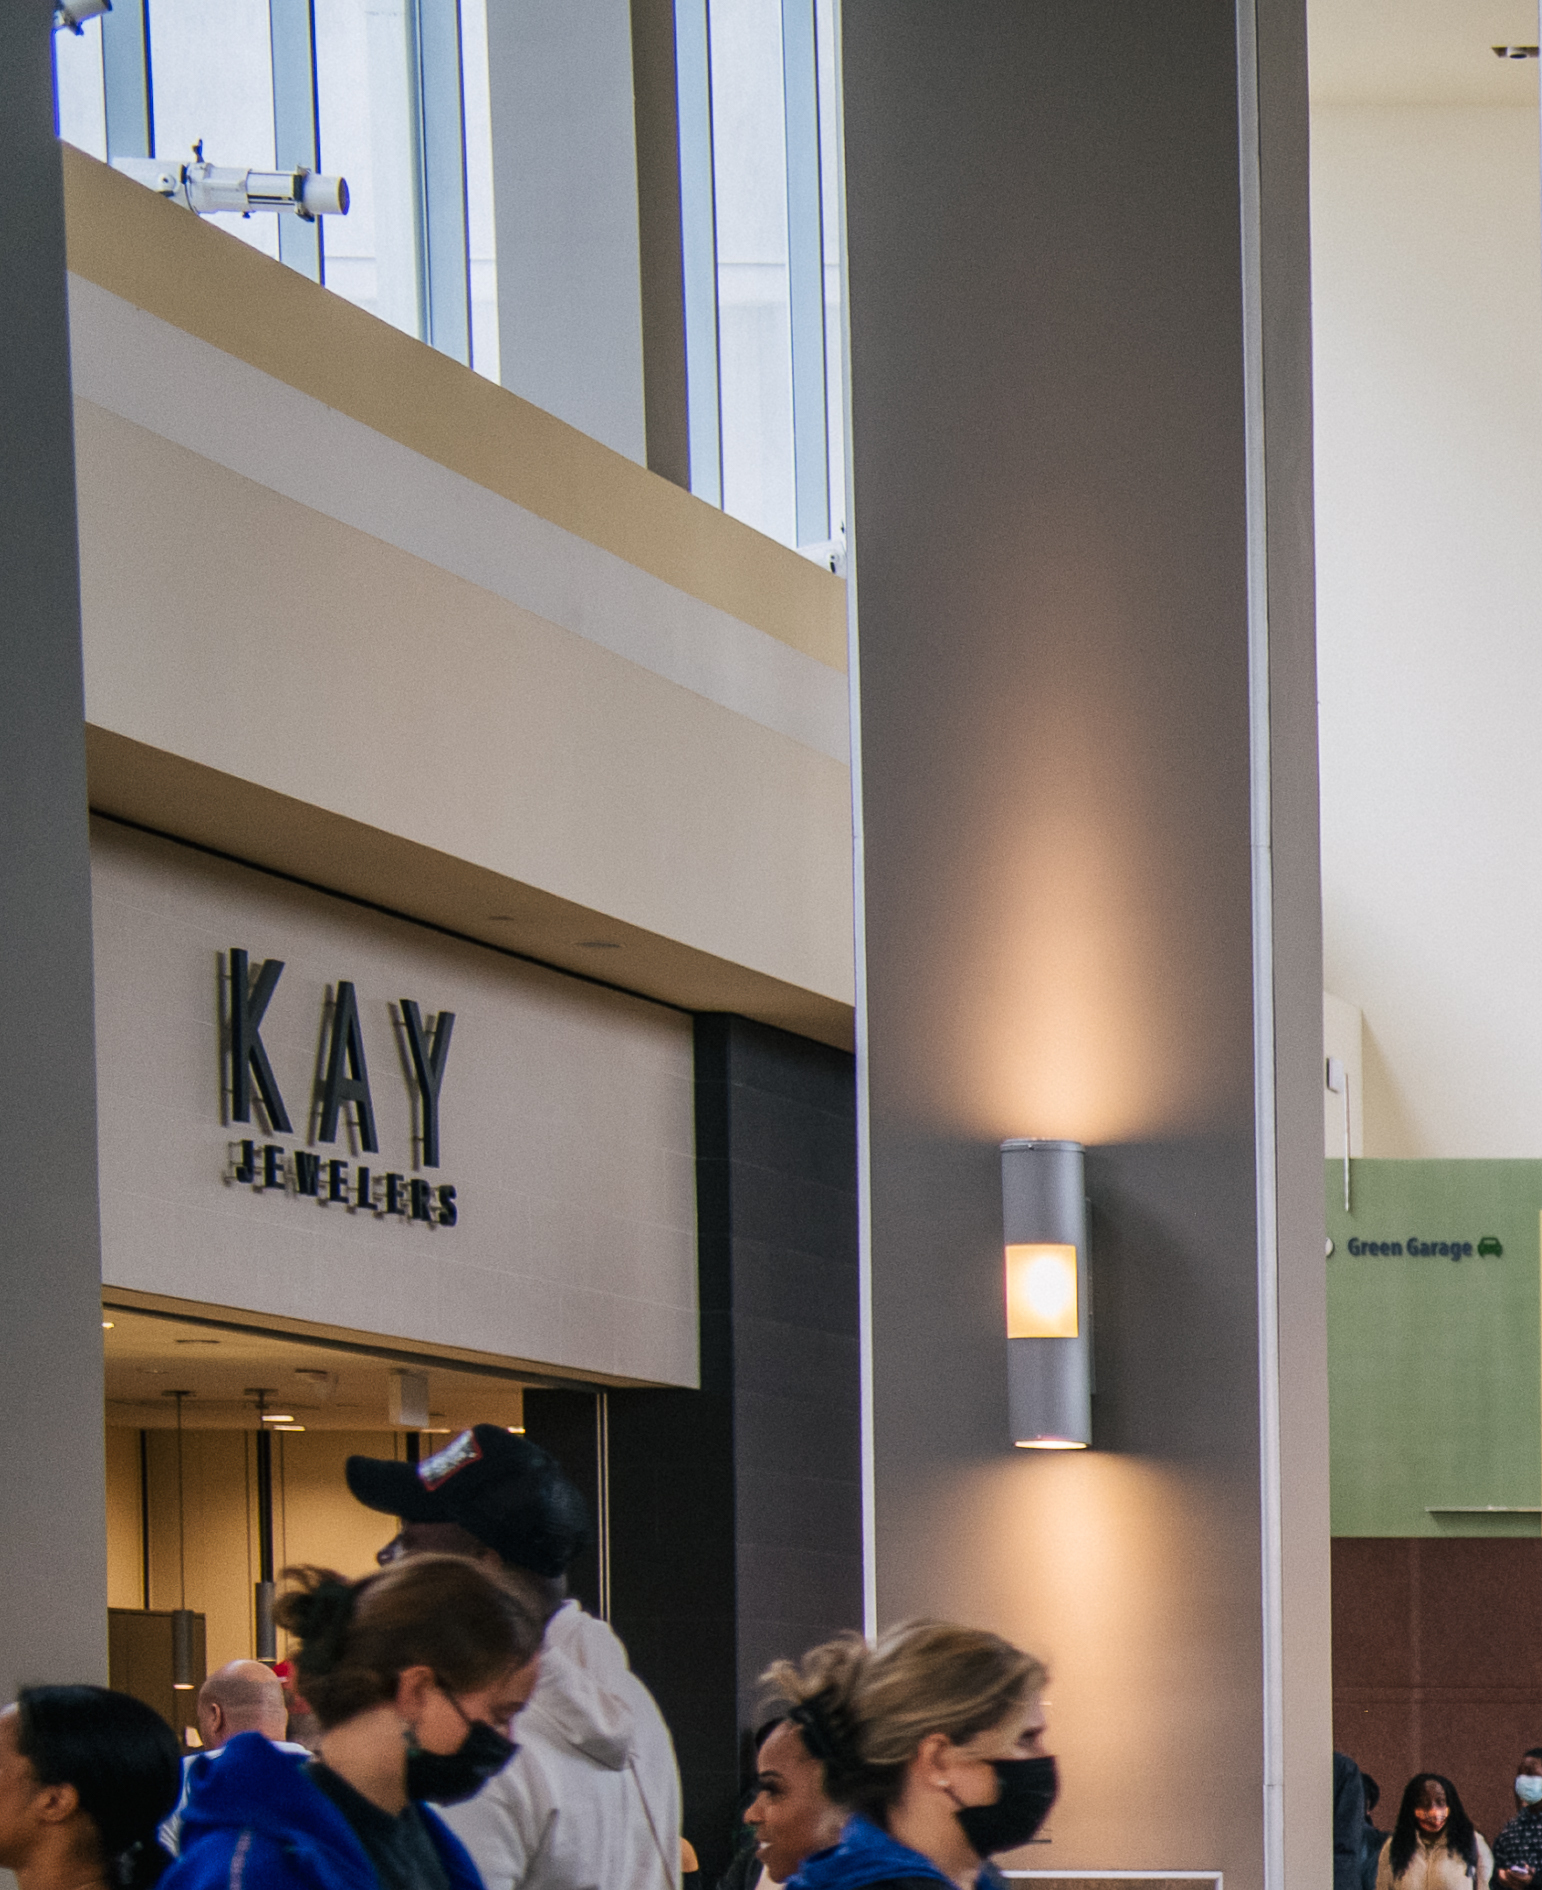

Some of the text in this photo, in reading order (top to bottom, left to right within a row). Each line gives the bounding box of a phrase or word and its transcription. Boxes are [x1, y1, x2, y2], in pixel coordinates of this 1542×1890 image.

[228, 947, 456, 1168] KAY
[234, 1138, 458, 1228] JEWELERS
[1347, 1236, 1473, 1262] Green Garage
